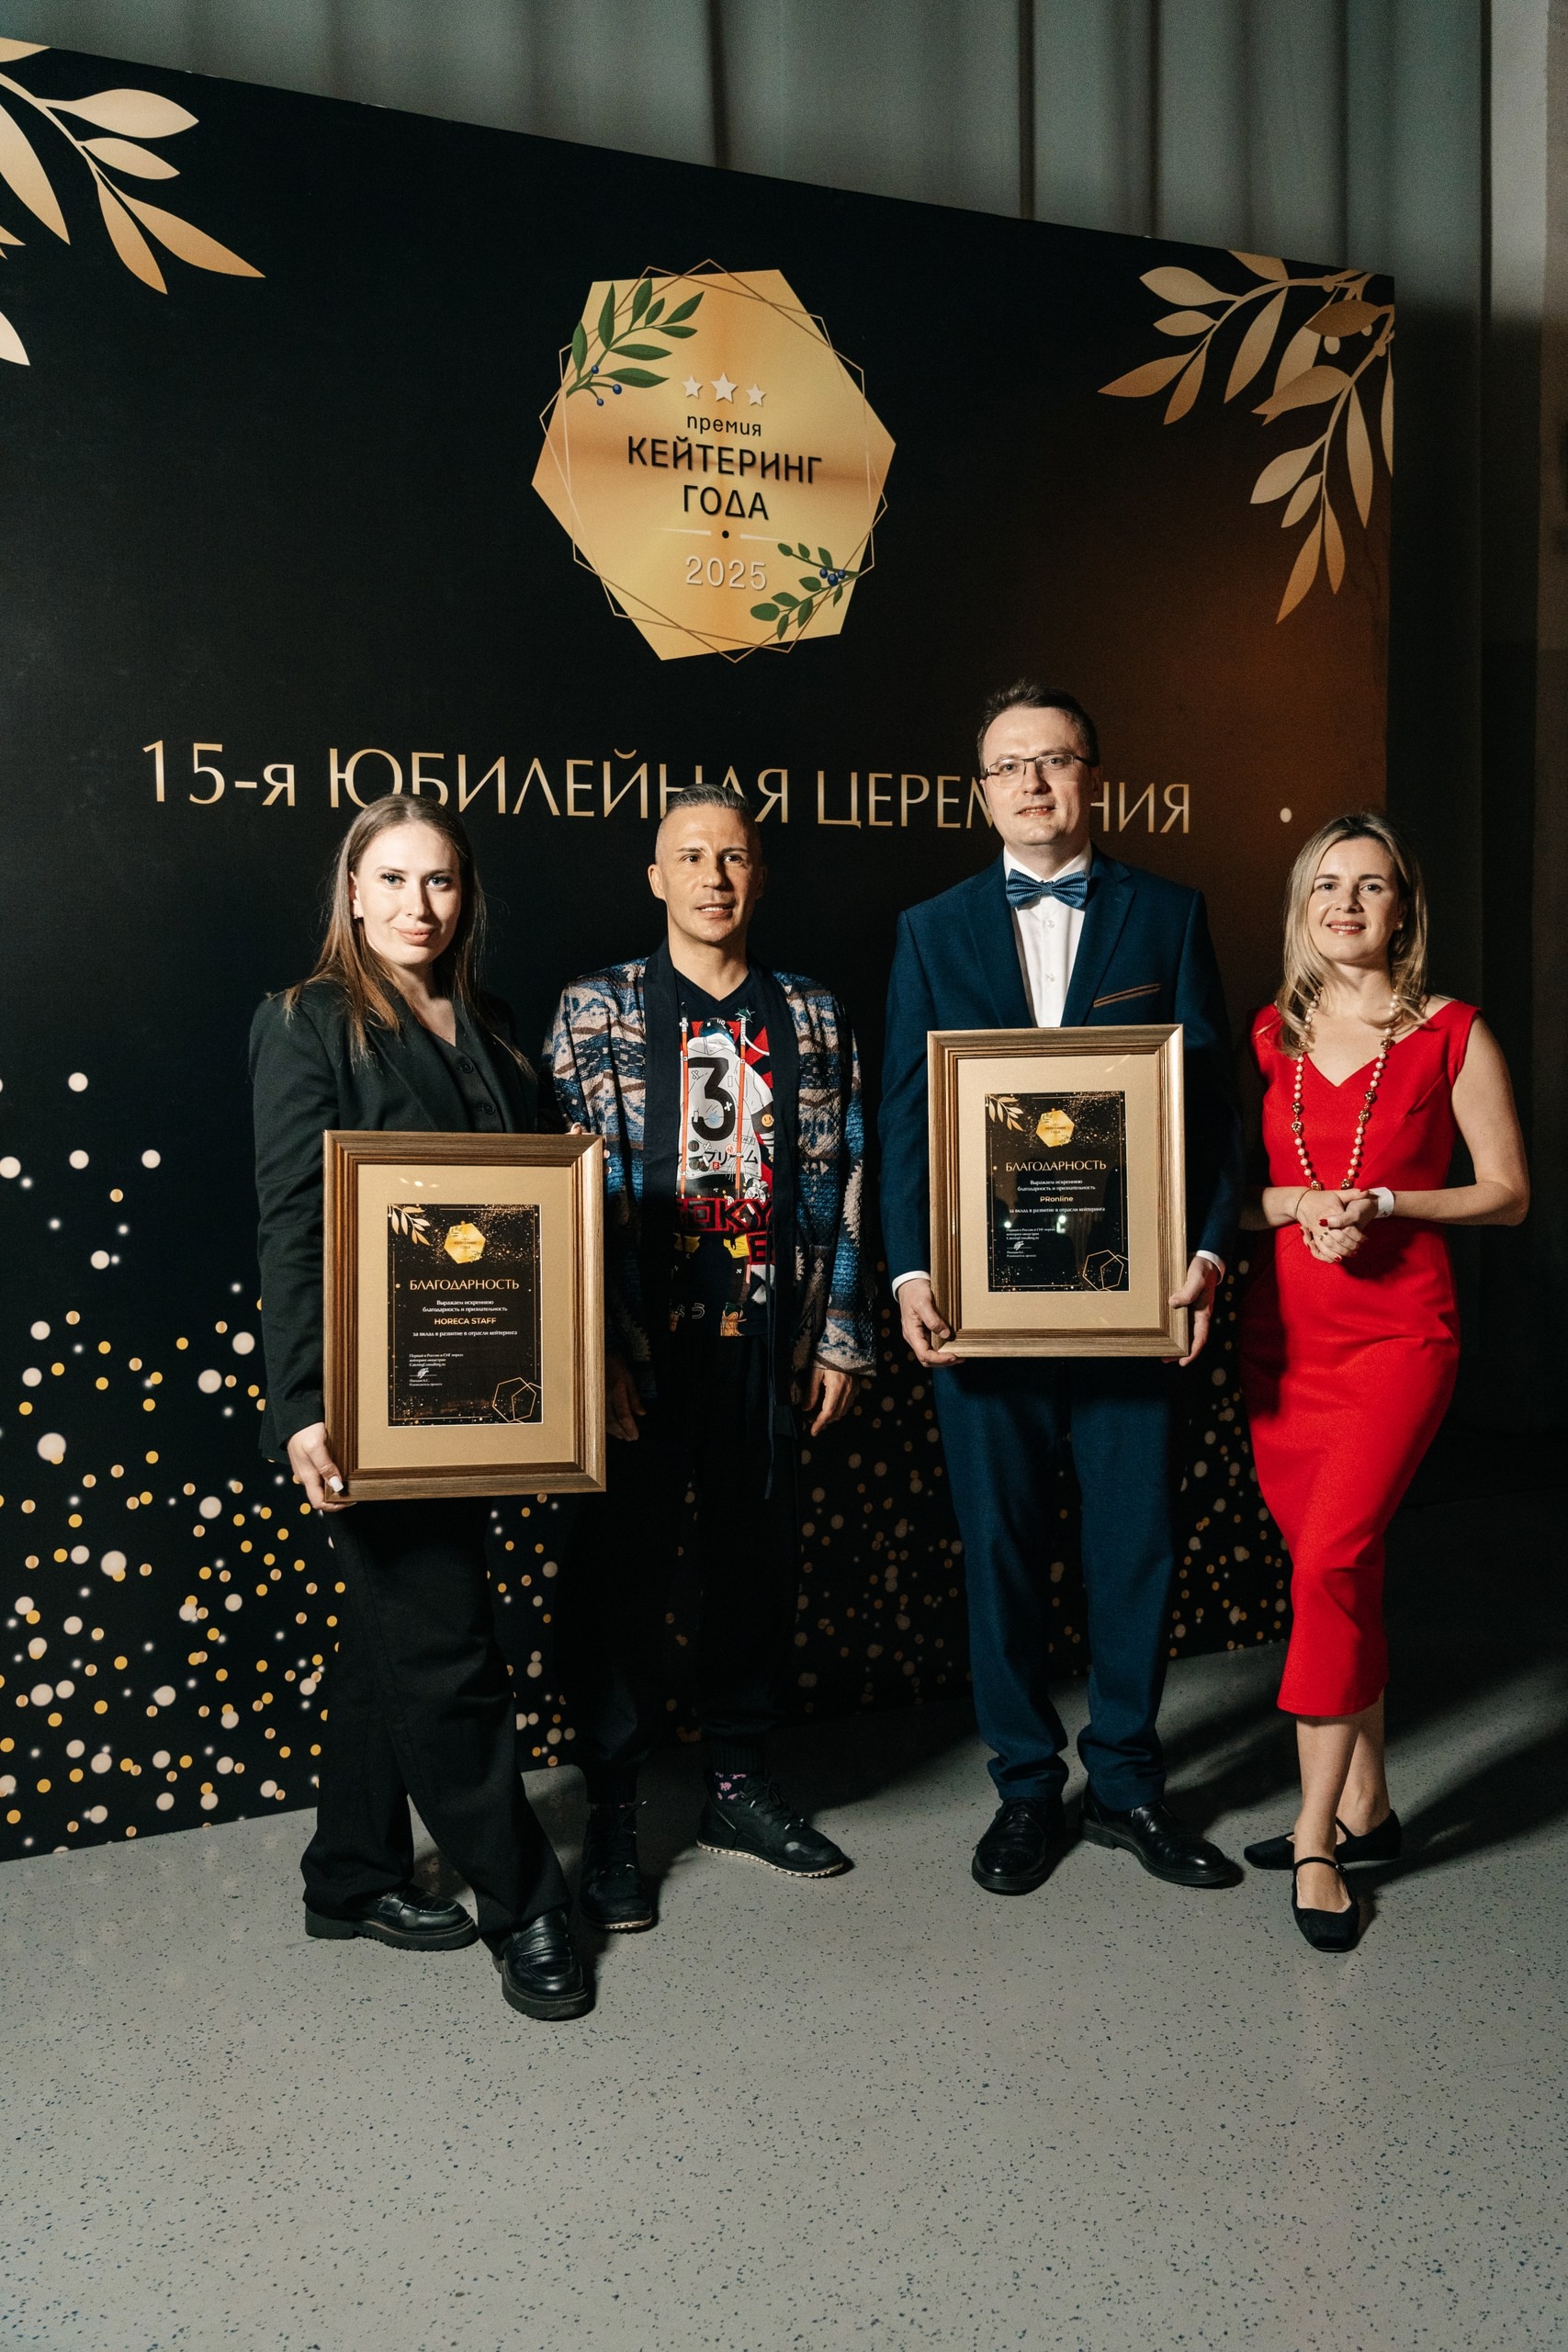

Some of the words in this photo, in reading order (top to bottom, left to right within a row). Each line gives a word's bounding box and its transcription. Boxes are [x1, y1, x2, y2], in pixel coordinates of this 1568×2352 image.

[686, 415, 761, 437] премия
[628, 435, 822, 484] КЕЙТЕРИНГ
[683, 484, 770, 521] ГОДА
[685, 556, 767, 591] 2025
[143, 741, 296, 807] 15-я
[688, 1057, 735, 1141] 3
[1006, 1160, 1107, 1171] БЛАГОДАРНОСТЬ
[410, 1279, 520, 1291] БЛАГОДАРНОСТЬ
